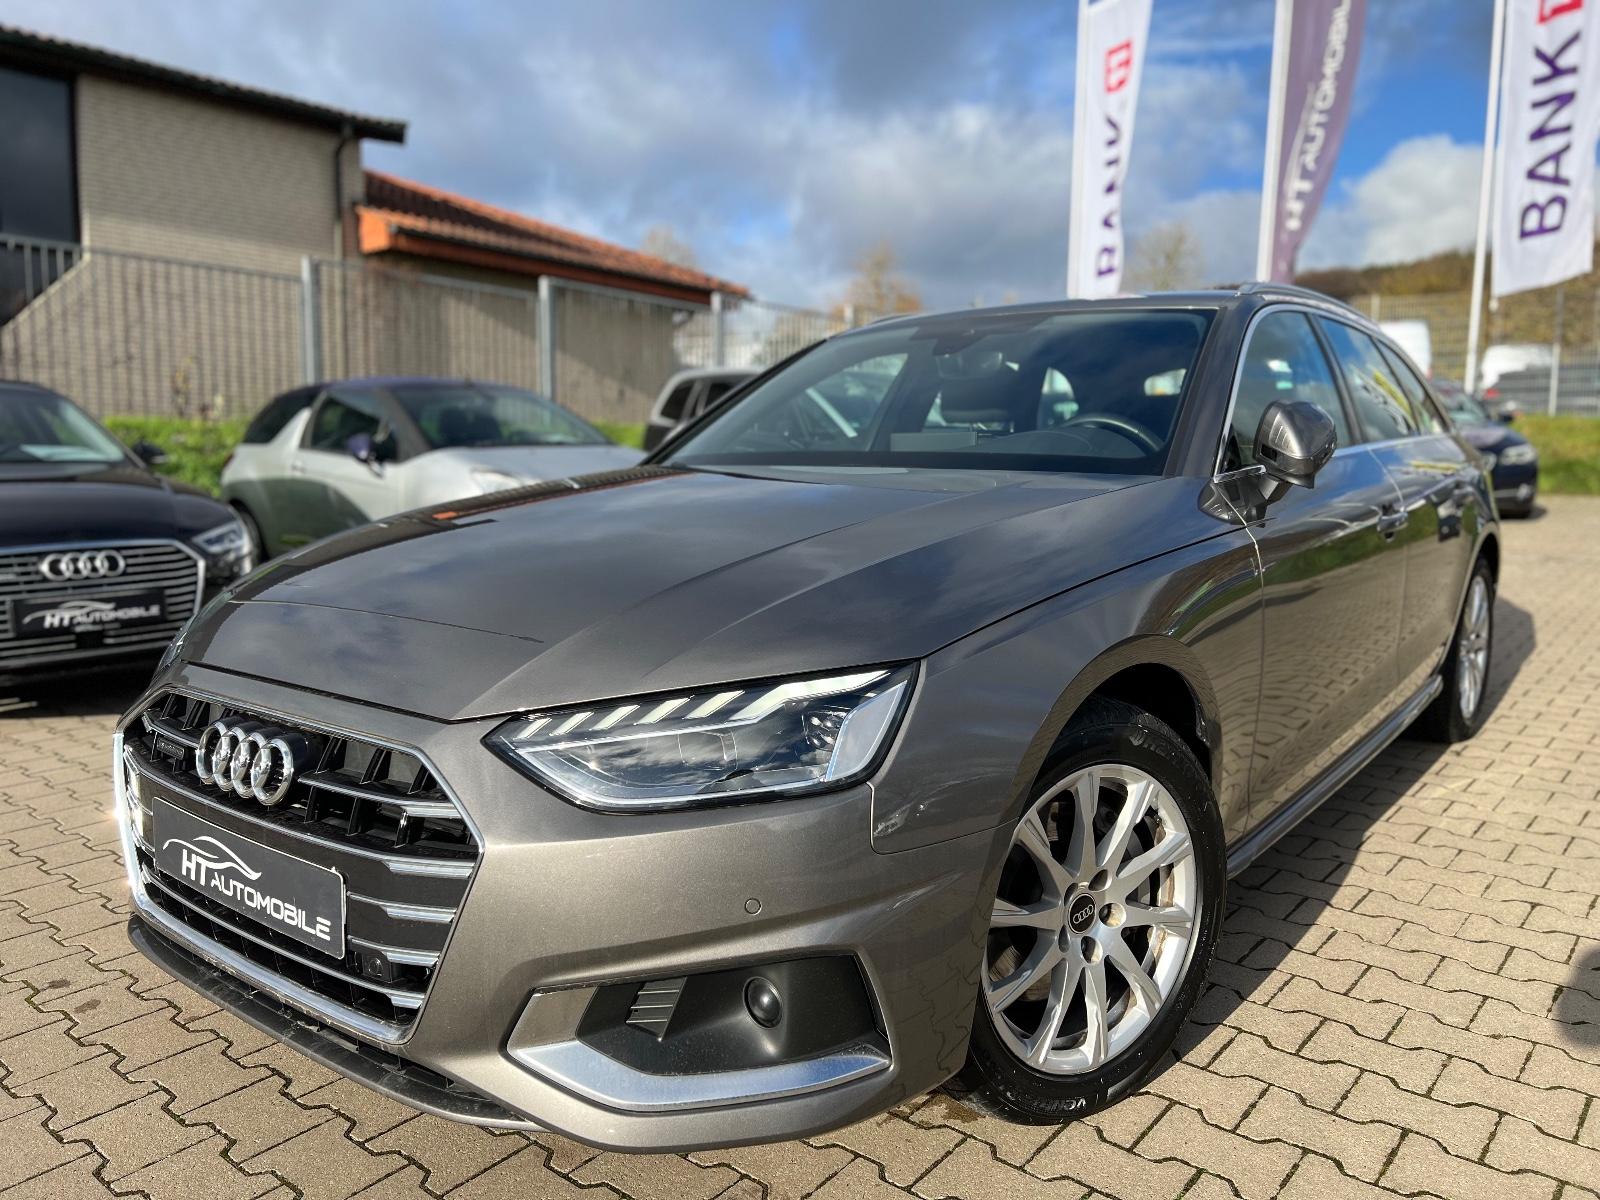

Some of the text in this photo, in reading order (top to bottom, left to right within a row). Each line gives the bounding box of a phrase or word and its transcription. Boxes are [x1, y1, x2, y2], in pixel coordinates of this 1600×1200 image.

[1519, 31, 1582, 241] BANK
[43, 604, 160, 628] HT AUTOMOBILE
[181, 848, 331, 942] HT AUTOMOBILE
